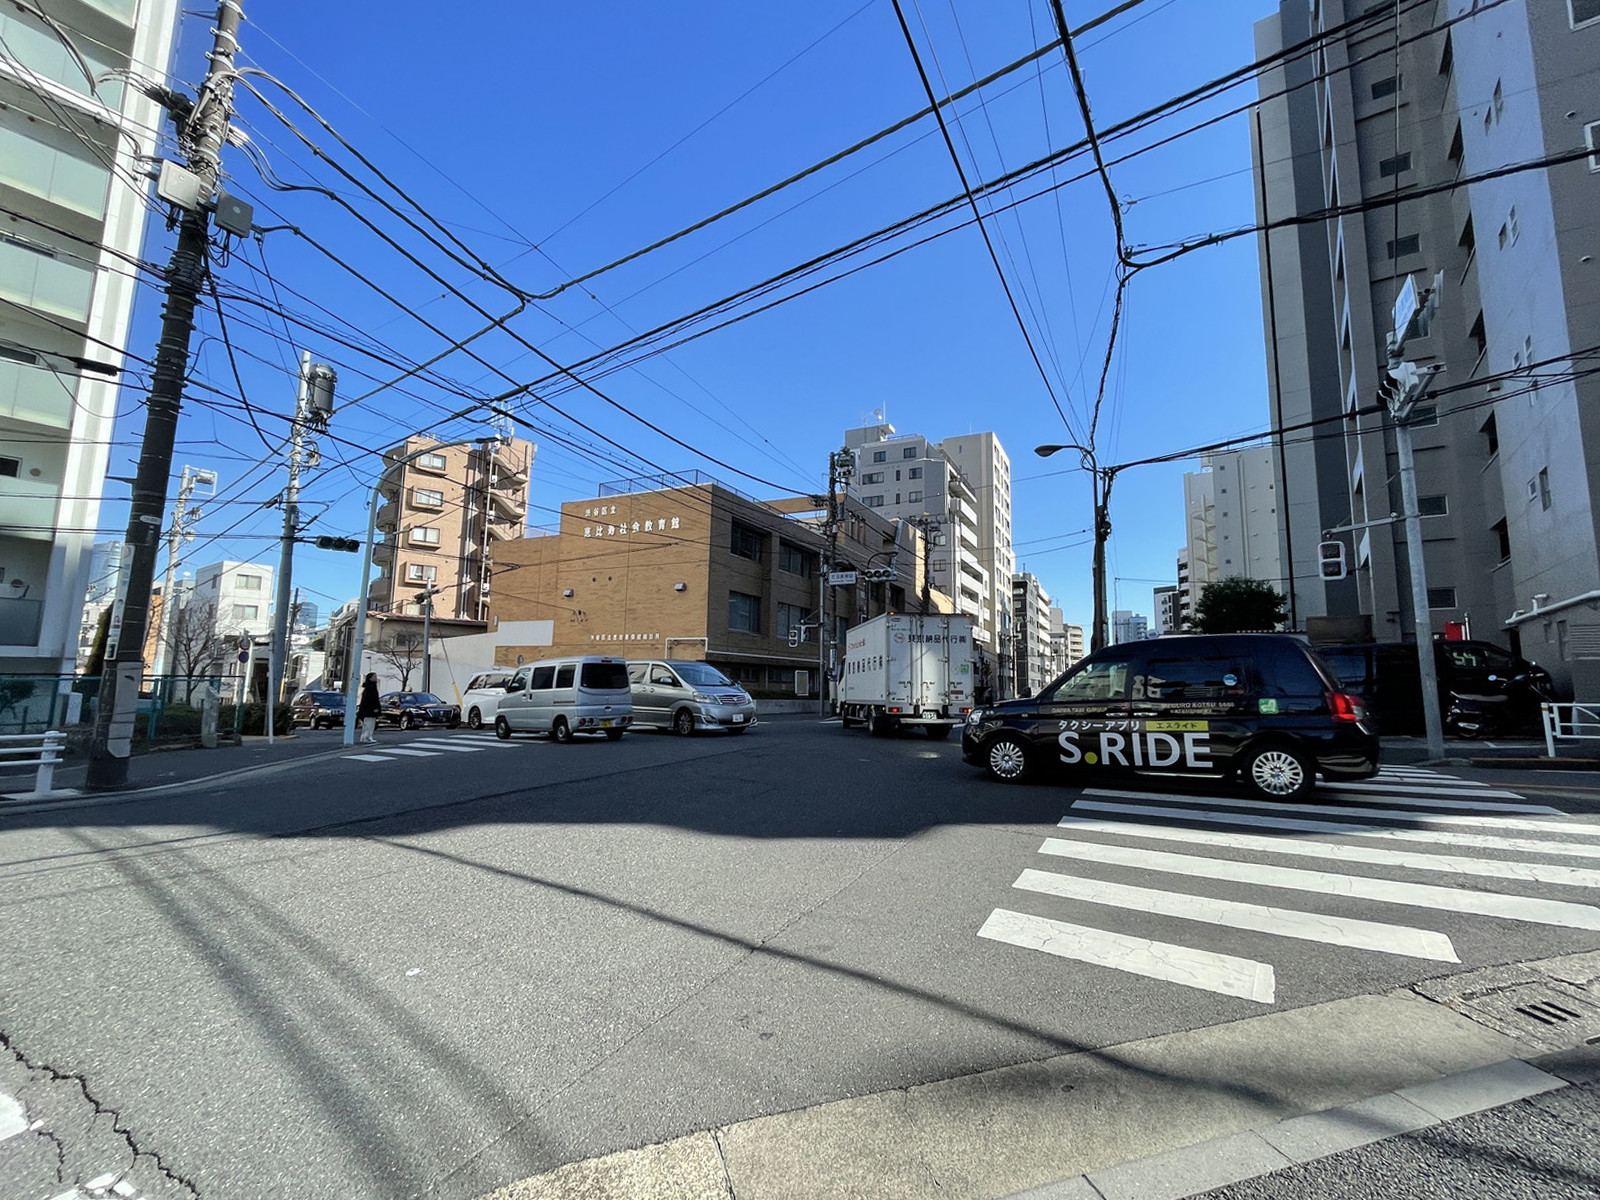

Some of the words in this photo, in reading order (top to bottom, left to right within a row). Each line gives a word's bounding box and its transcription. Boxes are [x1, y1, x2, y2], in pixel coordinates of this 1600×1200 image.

[583, 516, 680, 538] 恵比寿社会教育館
[1058, 720, 1140, 732] タクシーアプリ
[1156, 722, 1198, 730] エスライド
